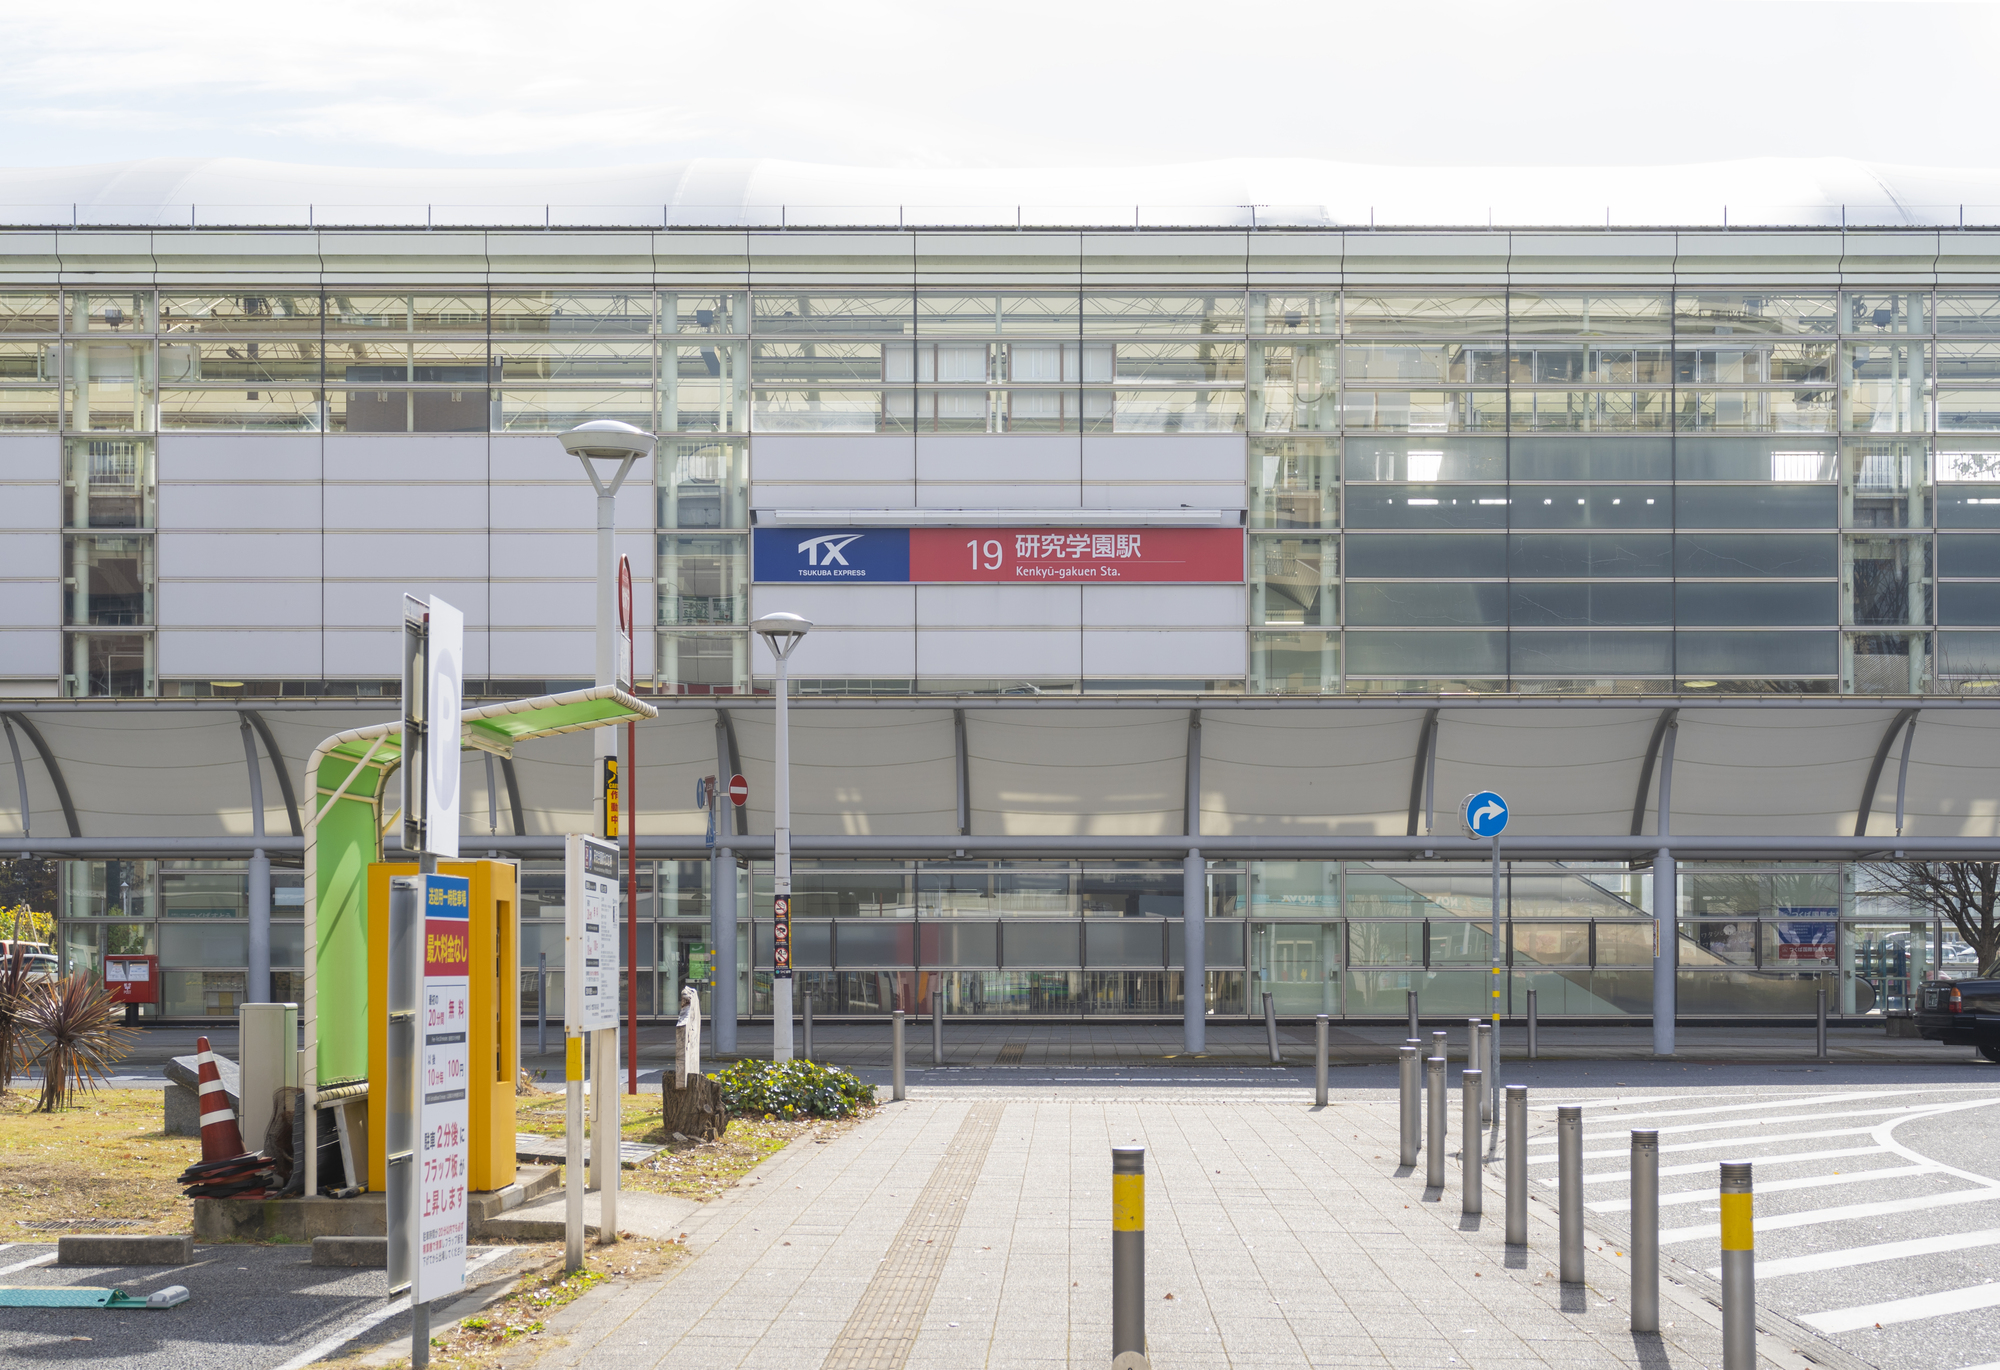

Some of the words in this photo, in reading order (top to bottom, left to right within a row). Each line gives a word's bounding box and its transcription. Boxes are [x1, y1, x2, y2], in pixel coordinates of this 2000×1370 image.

[798, 533, 865, 566] TX
[966, 539, 1003, 570] 19
[1015, 533, 1142, 558] 研究学園駅
[1016, 565, 1097, 579] Kenkyū-gakuen
[1100, 565, 1121, 577] Sta.
[437, 672, 455, 781] P
[426, 933, 467, 964] 最大料金なし
[423, 1184, 464, 1218] 上昇します
